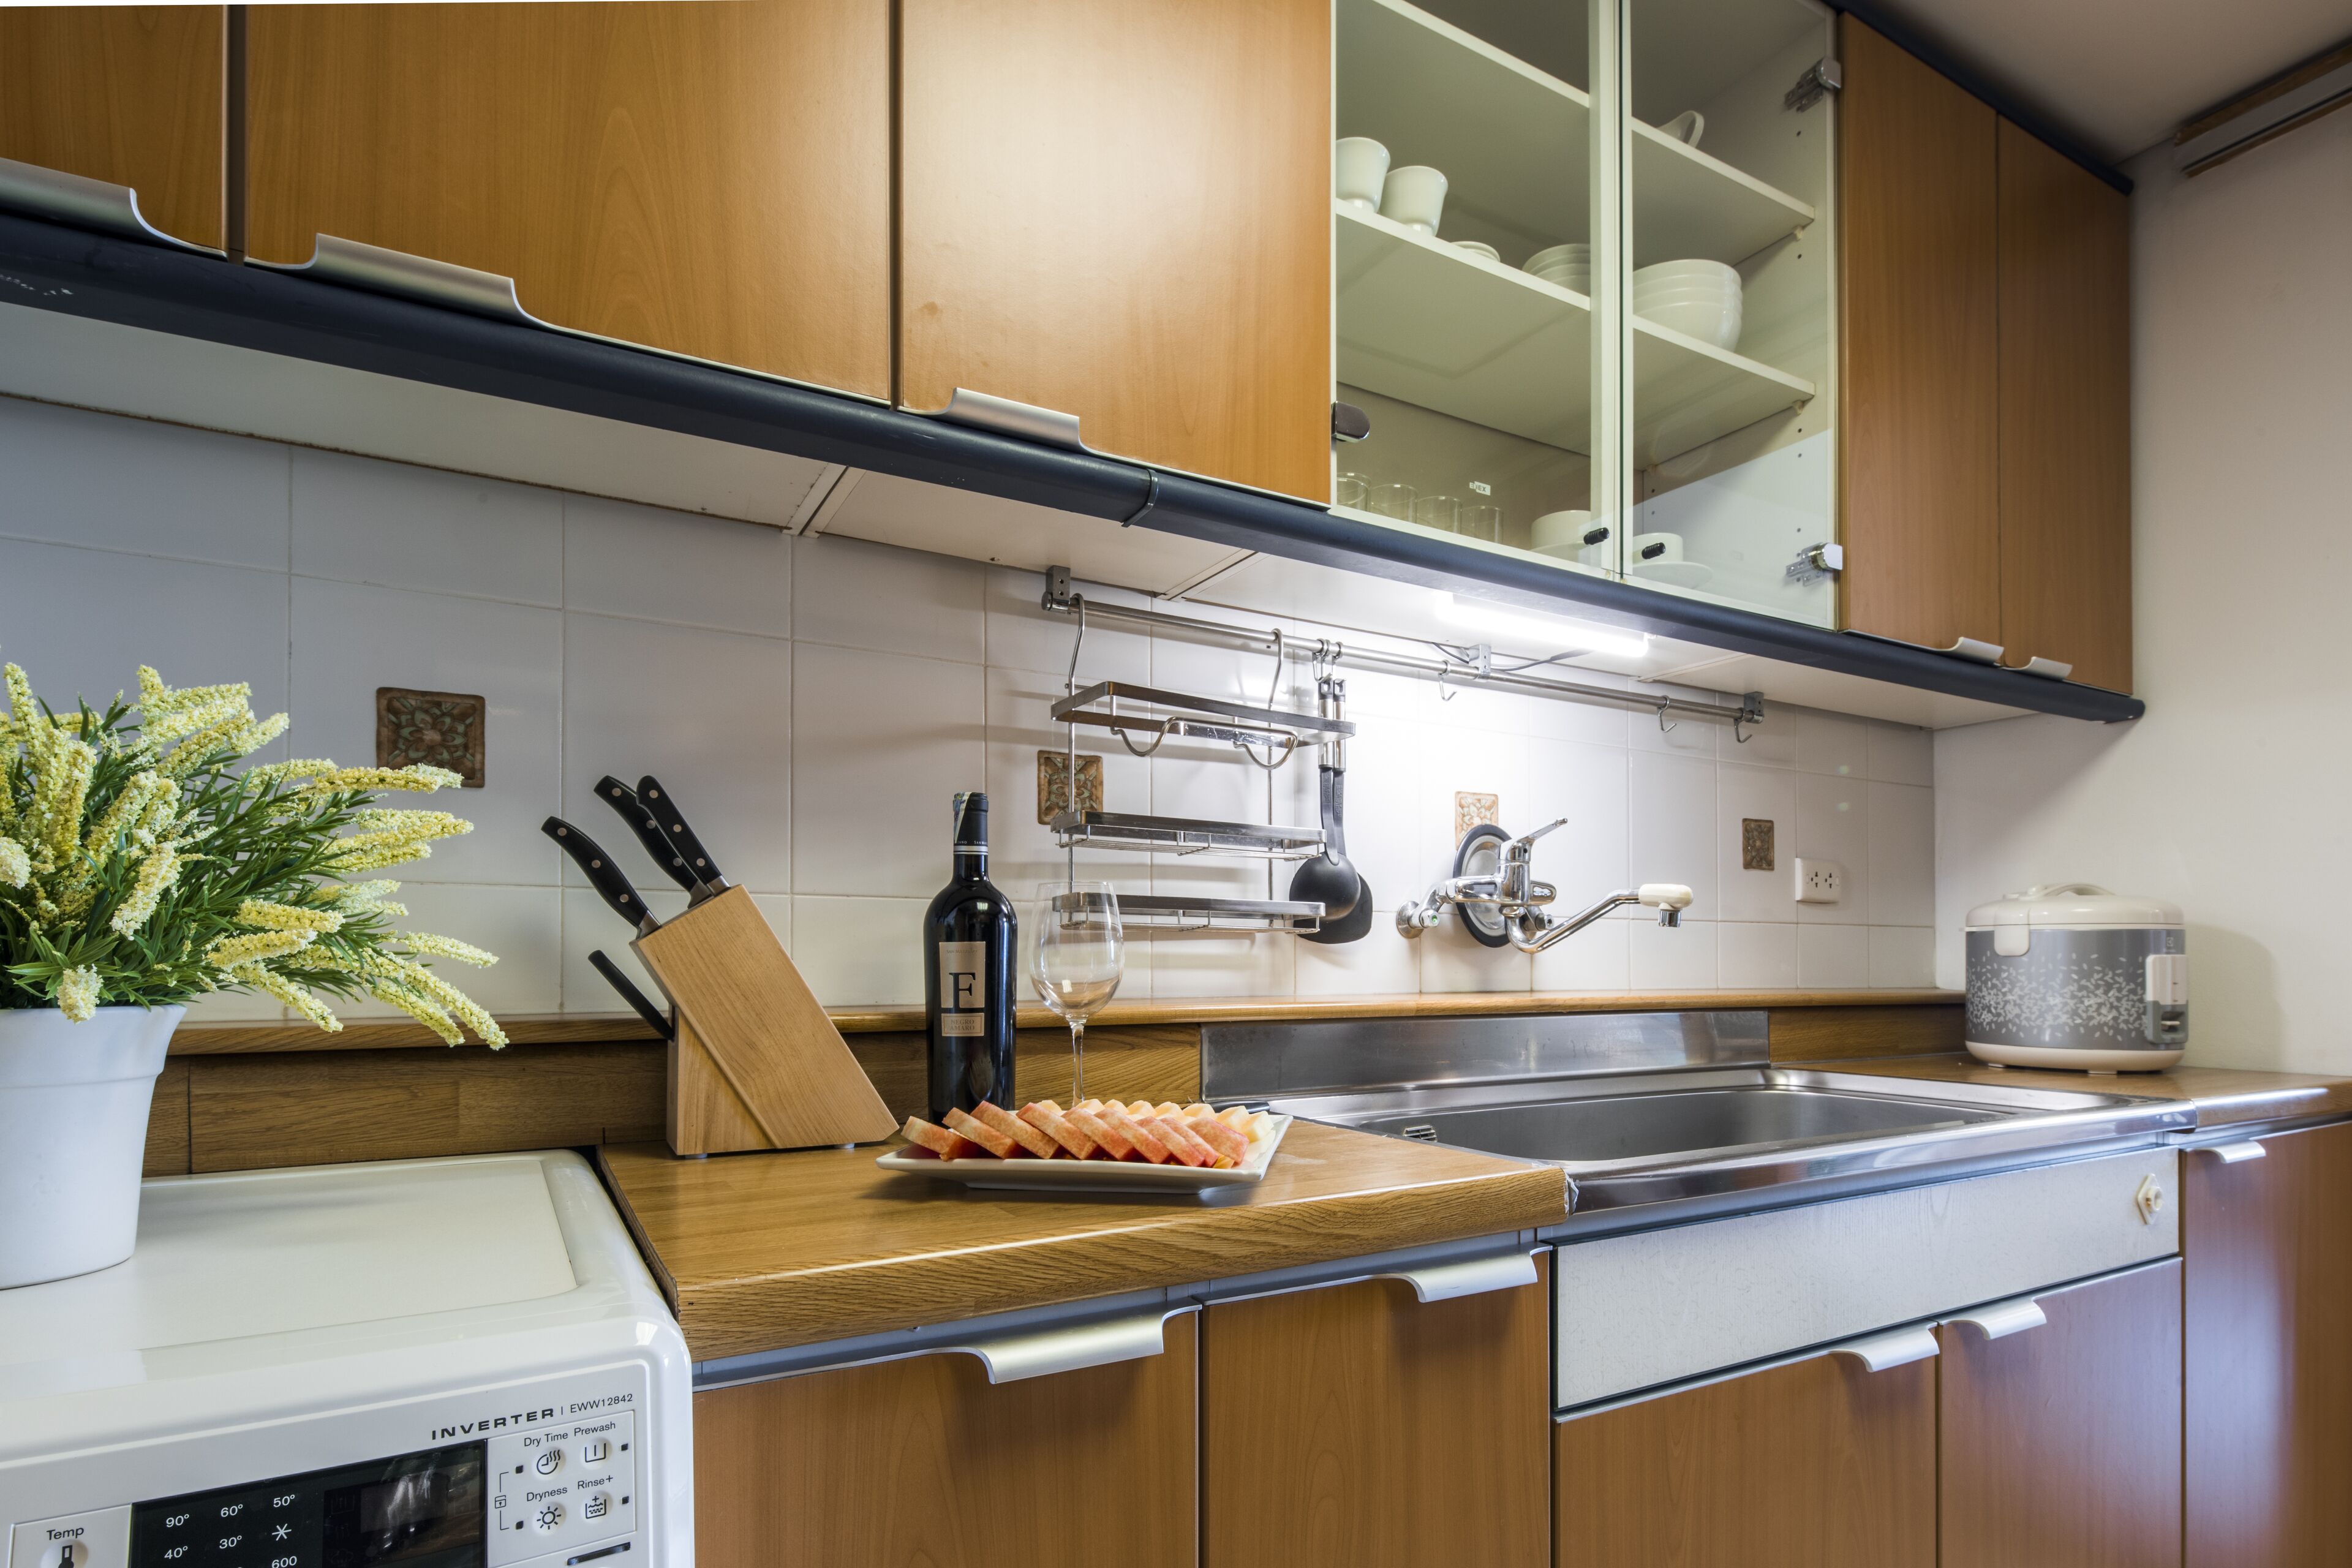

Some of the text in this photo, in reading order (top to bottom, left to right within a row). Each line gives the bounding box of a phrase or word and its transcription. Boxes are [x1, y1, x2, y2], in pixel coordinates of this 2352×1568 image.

[431, 1393, 633, 1440] INVERTER EWW12842
[574, 1421, 616, 1436] Prewash
[524, 1431, 568, 1447] Dry Time
[577, 1474, 614, 1490] Rinse+
[273, 1494, 295, 1508] 50°
[526, 1486, 568, 1502] Dryness
[220, 1504, 243, 1518] 60°
[166, 1513, 190, 1528] 90°
[46, 1527, 85, 1541] Temp
[219, 1535, 243, 1550] 30°
[164, 1545, 189, 1560] 40°
[271, 1555, 298, 1568] 600
